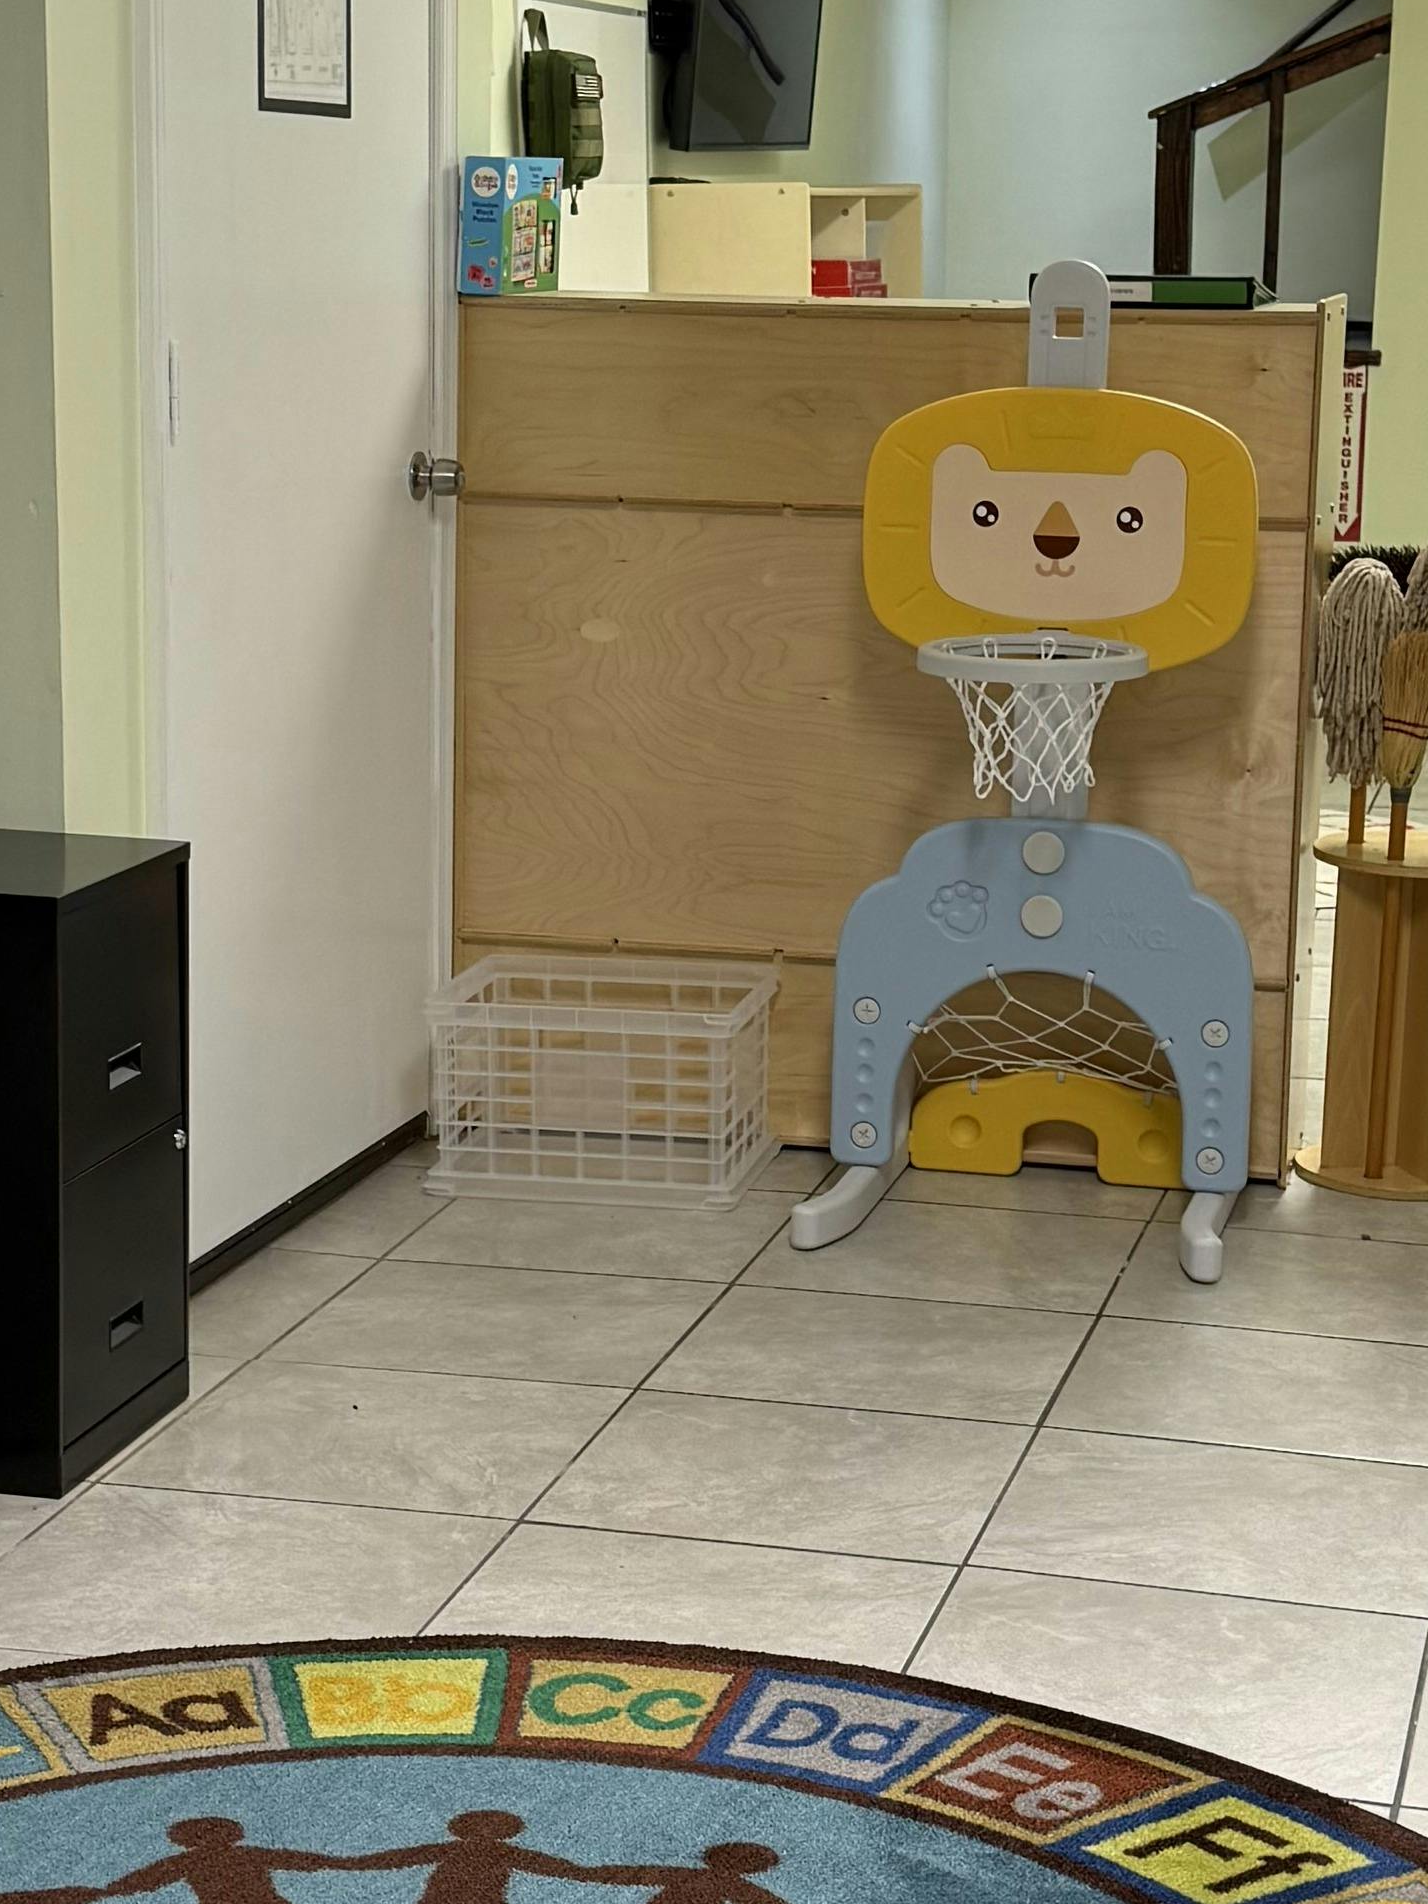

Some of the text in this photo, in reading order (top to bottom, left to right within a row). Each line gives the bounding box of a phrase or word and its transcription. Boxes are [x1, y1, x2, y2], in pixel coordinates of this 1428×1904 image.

[1343, 372, 1363, 388] IRE
[1338, 392, 1355, 524] EXTINGUISHER
[89, 1688, 261, 1746] Aa
[307, 1674, 477, 1725] Bb
[529, 1672, 709, 1730] Cc
[748, 1699, 919, 1765] Dd
[936, 1742, 1104, 1819] Ee
[1124, 1815, 1338, 1892] Ff
